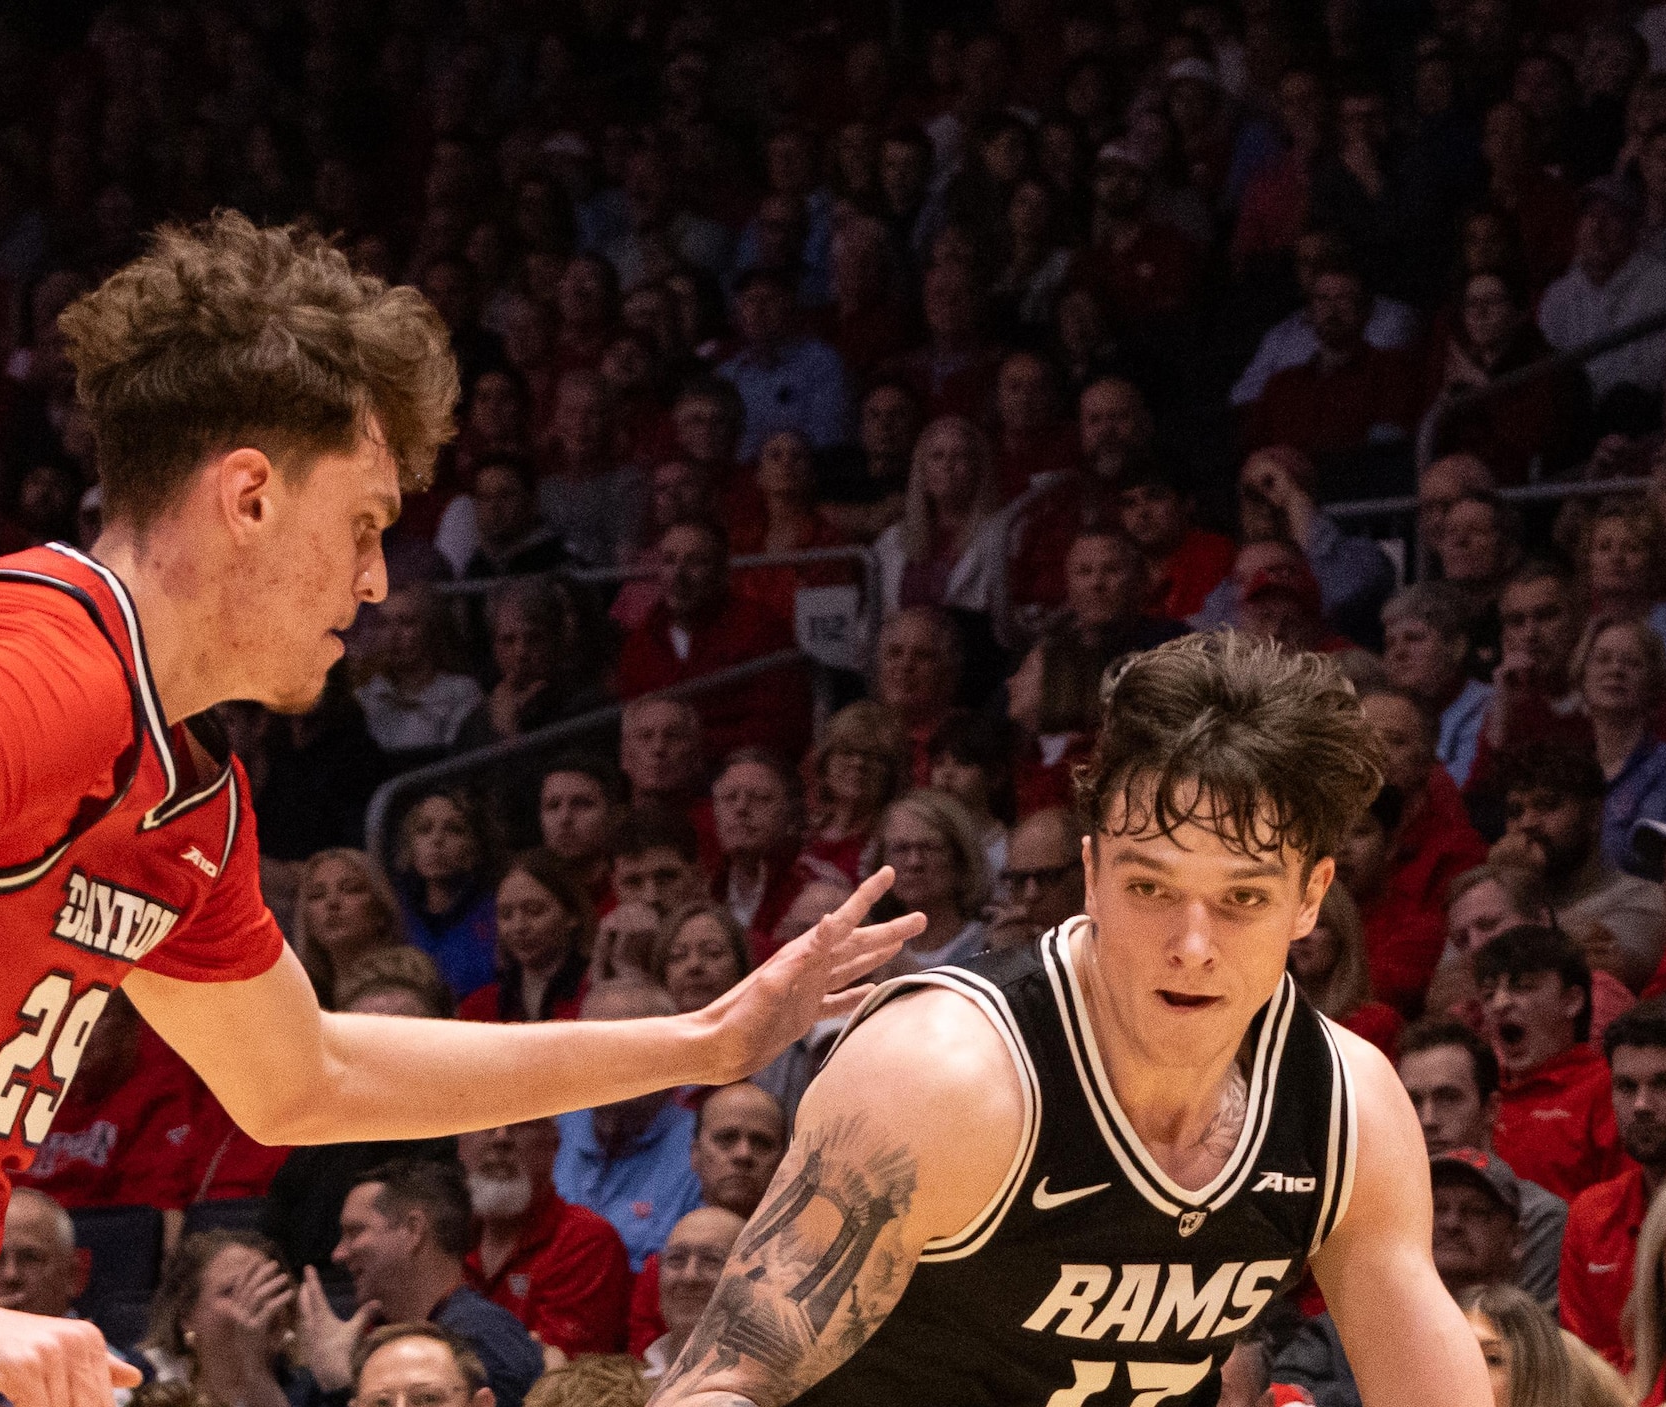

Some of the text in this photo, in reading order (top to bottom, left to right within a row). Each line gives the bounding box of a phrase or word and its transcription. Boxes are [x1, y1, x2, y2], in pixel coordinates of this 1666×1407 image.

[181, 846, 218, 878] A10
[1250, 1171, 1317, 1193] A10
[1021, 1258, 1293, 1343] RAMS
